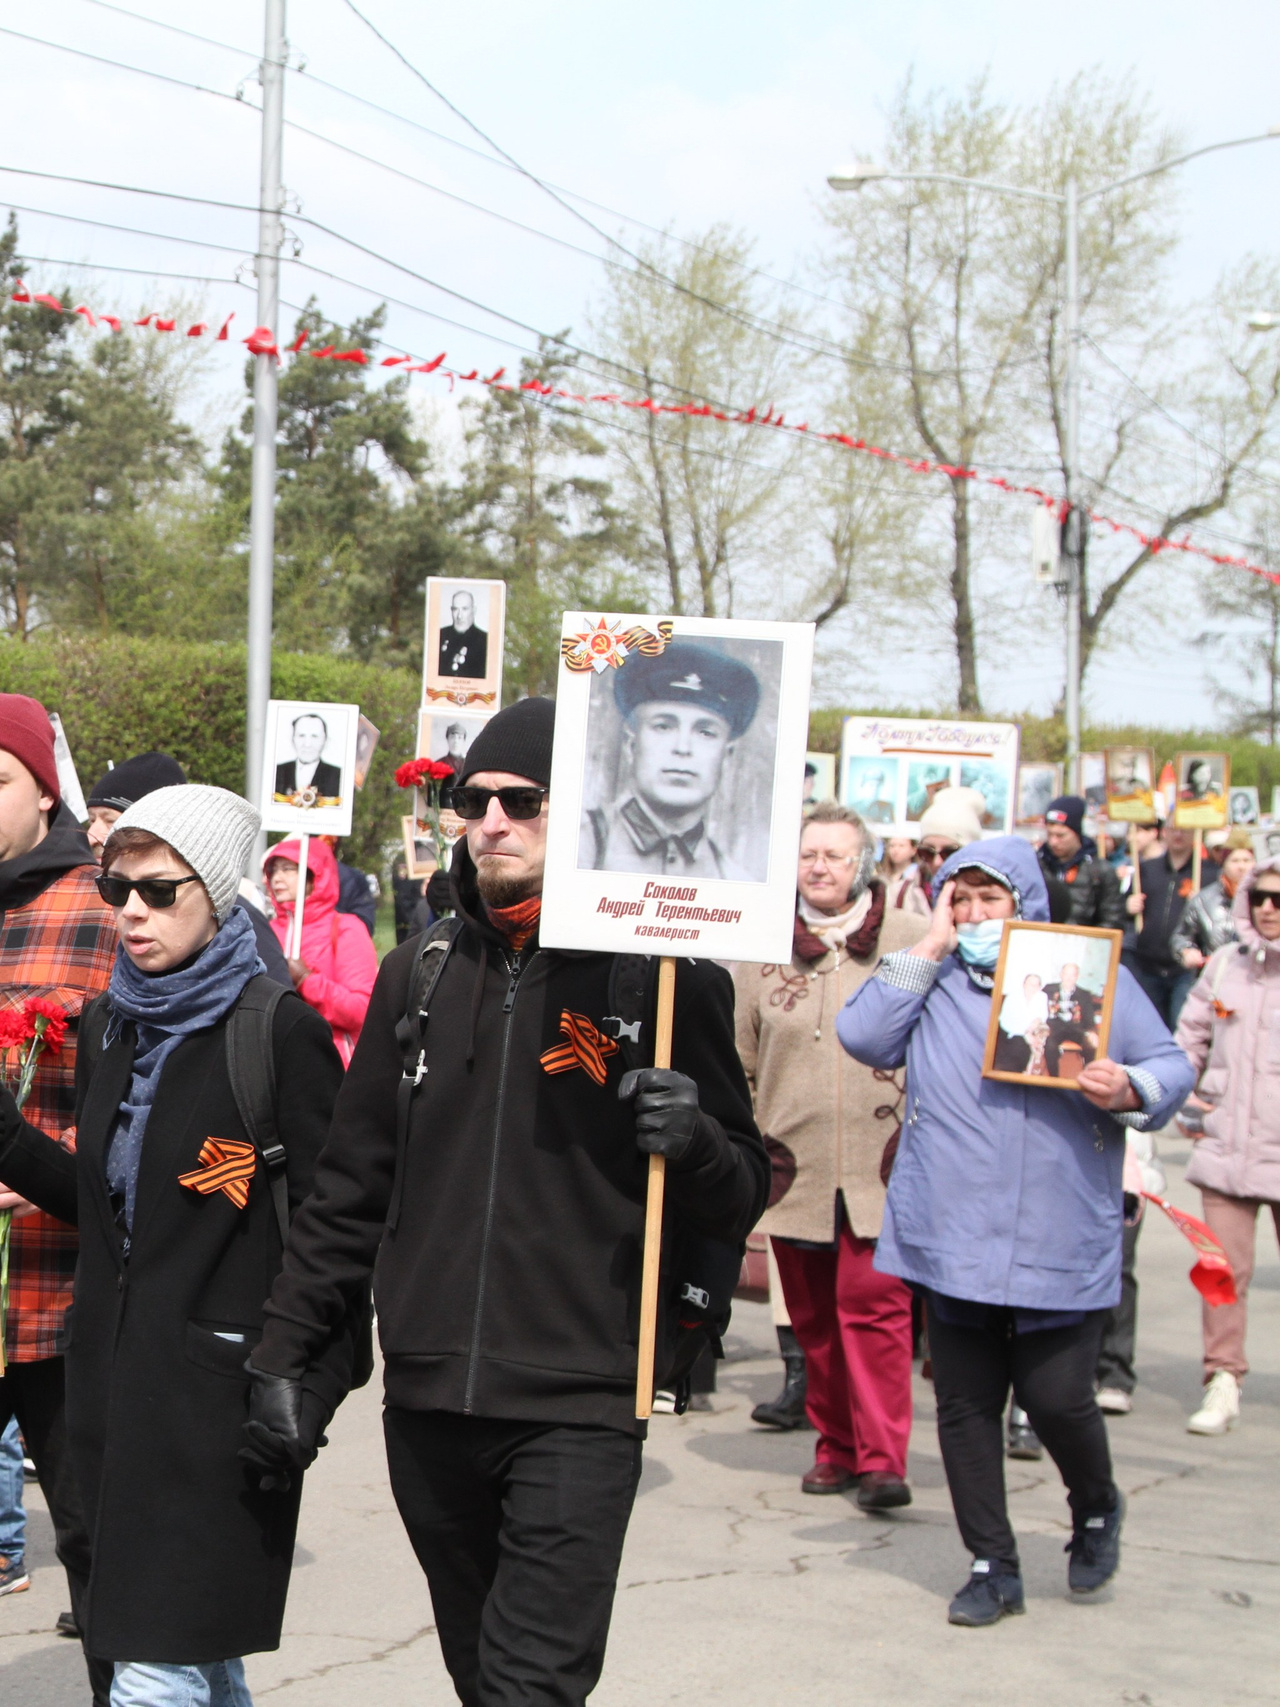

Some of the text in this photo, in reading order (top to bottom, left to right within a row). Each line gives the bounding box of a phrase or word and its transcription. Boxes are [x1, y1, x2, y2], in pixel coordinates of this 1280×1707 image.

[643, 881, 698, 901] Соколов
[596, 897, 742, 924] Андрей Терентьевич
[634, 925, 700, 941] кавалерист
